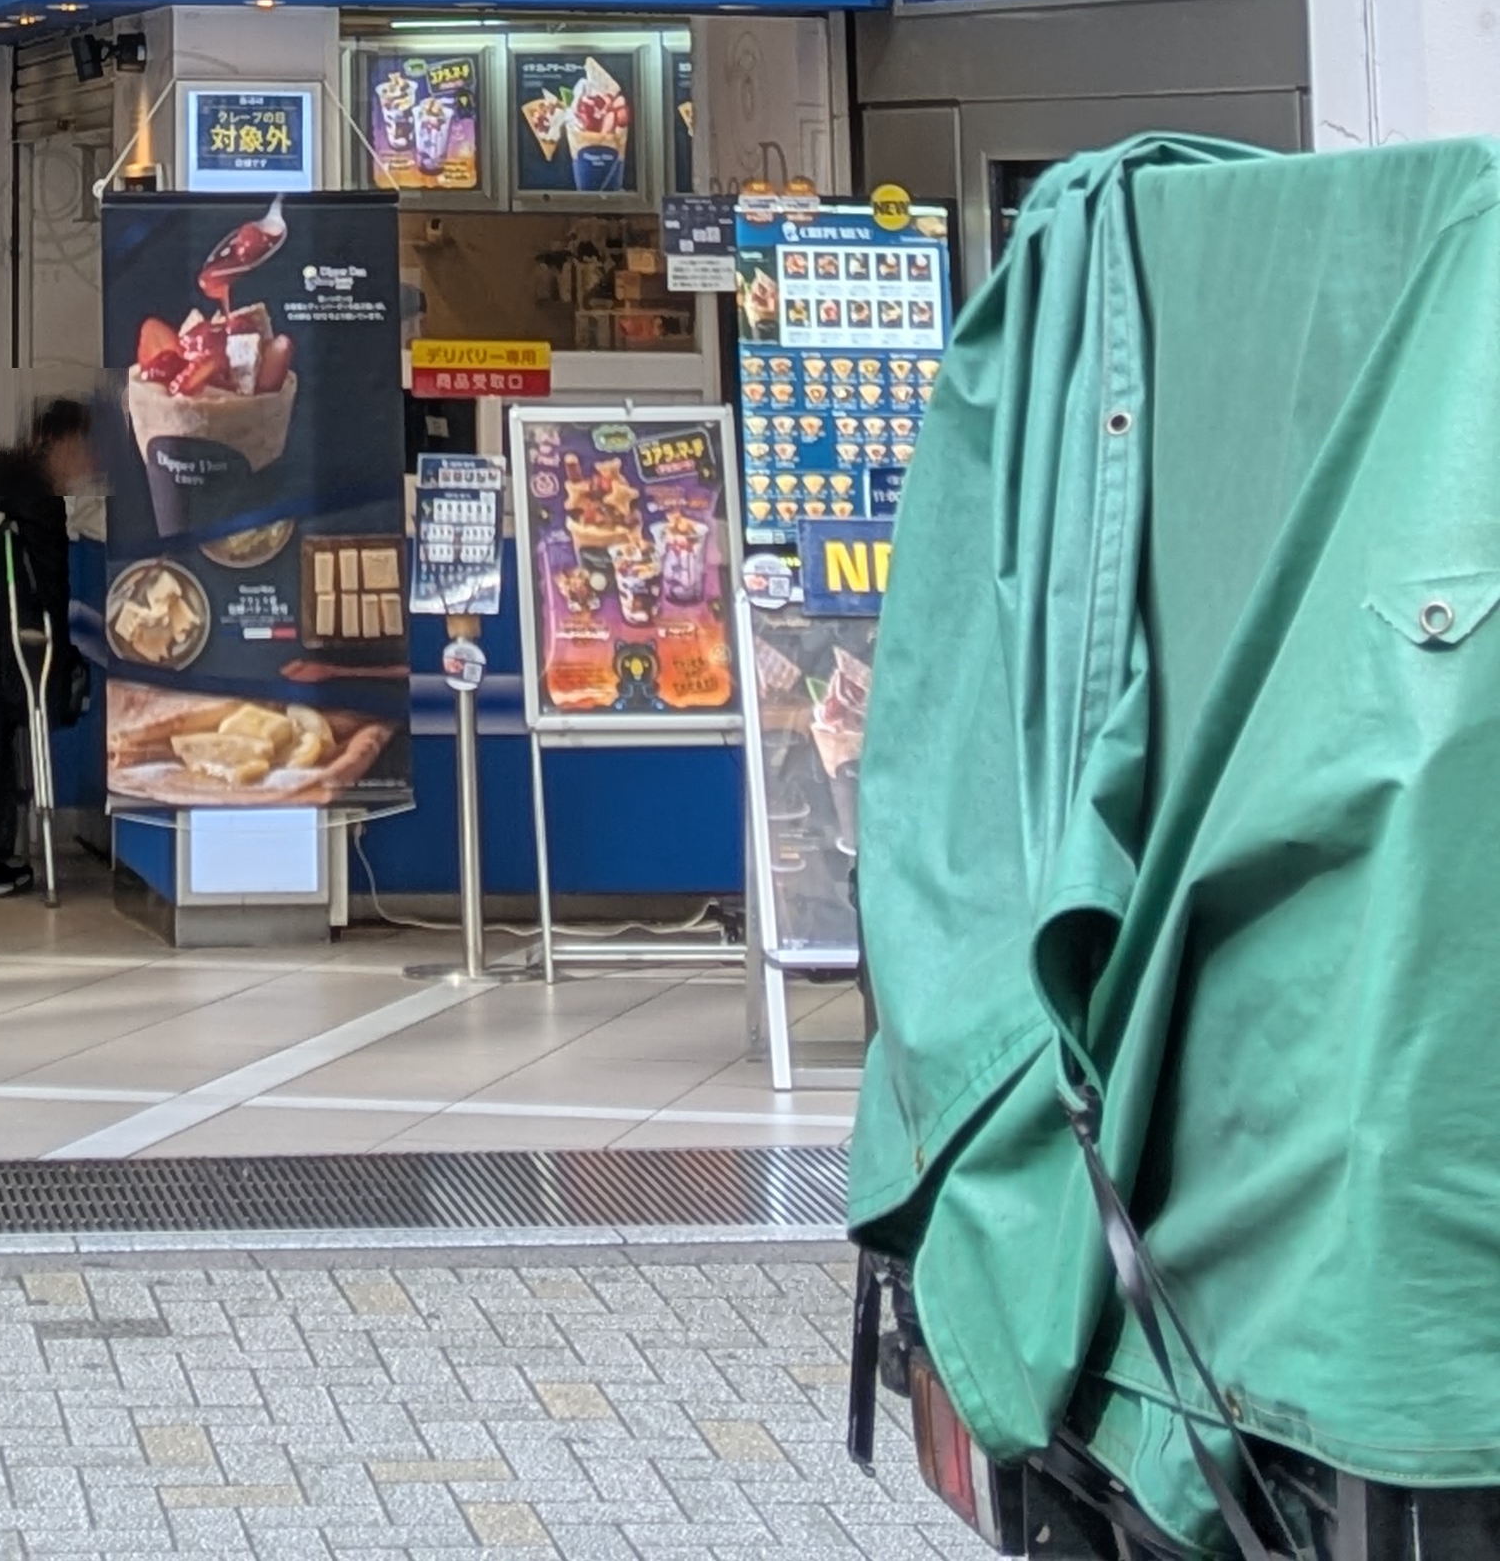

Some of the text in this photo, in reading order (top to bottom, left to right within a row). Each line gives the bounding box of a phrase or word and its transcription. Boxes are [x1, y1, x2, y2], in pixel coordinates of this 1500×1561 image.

[210, 124, 292, 153] 対象外
[874, 200, 909, 216] NEW
[426, 346, 537, 366] デリバリー専用
[435, 372, 524, 390] 商品受取口
